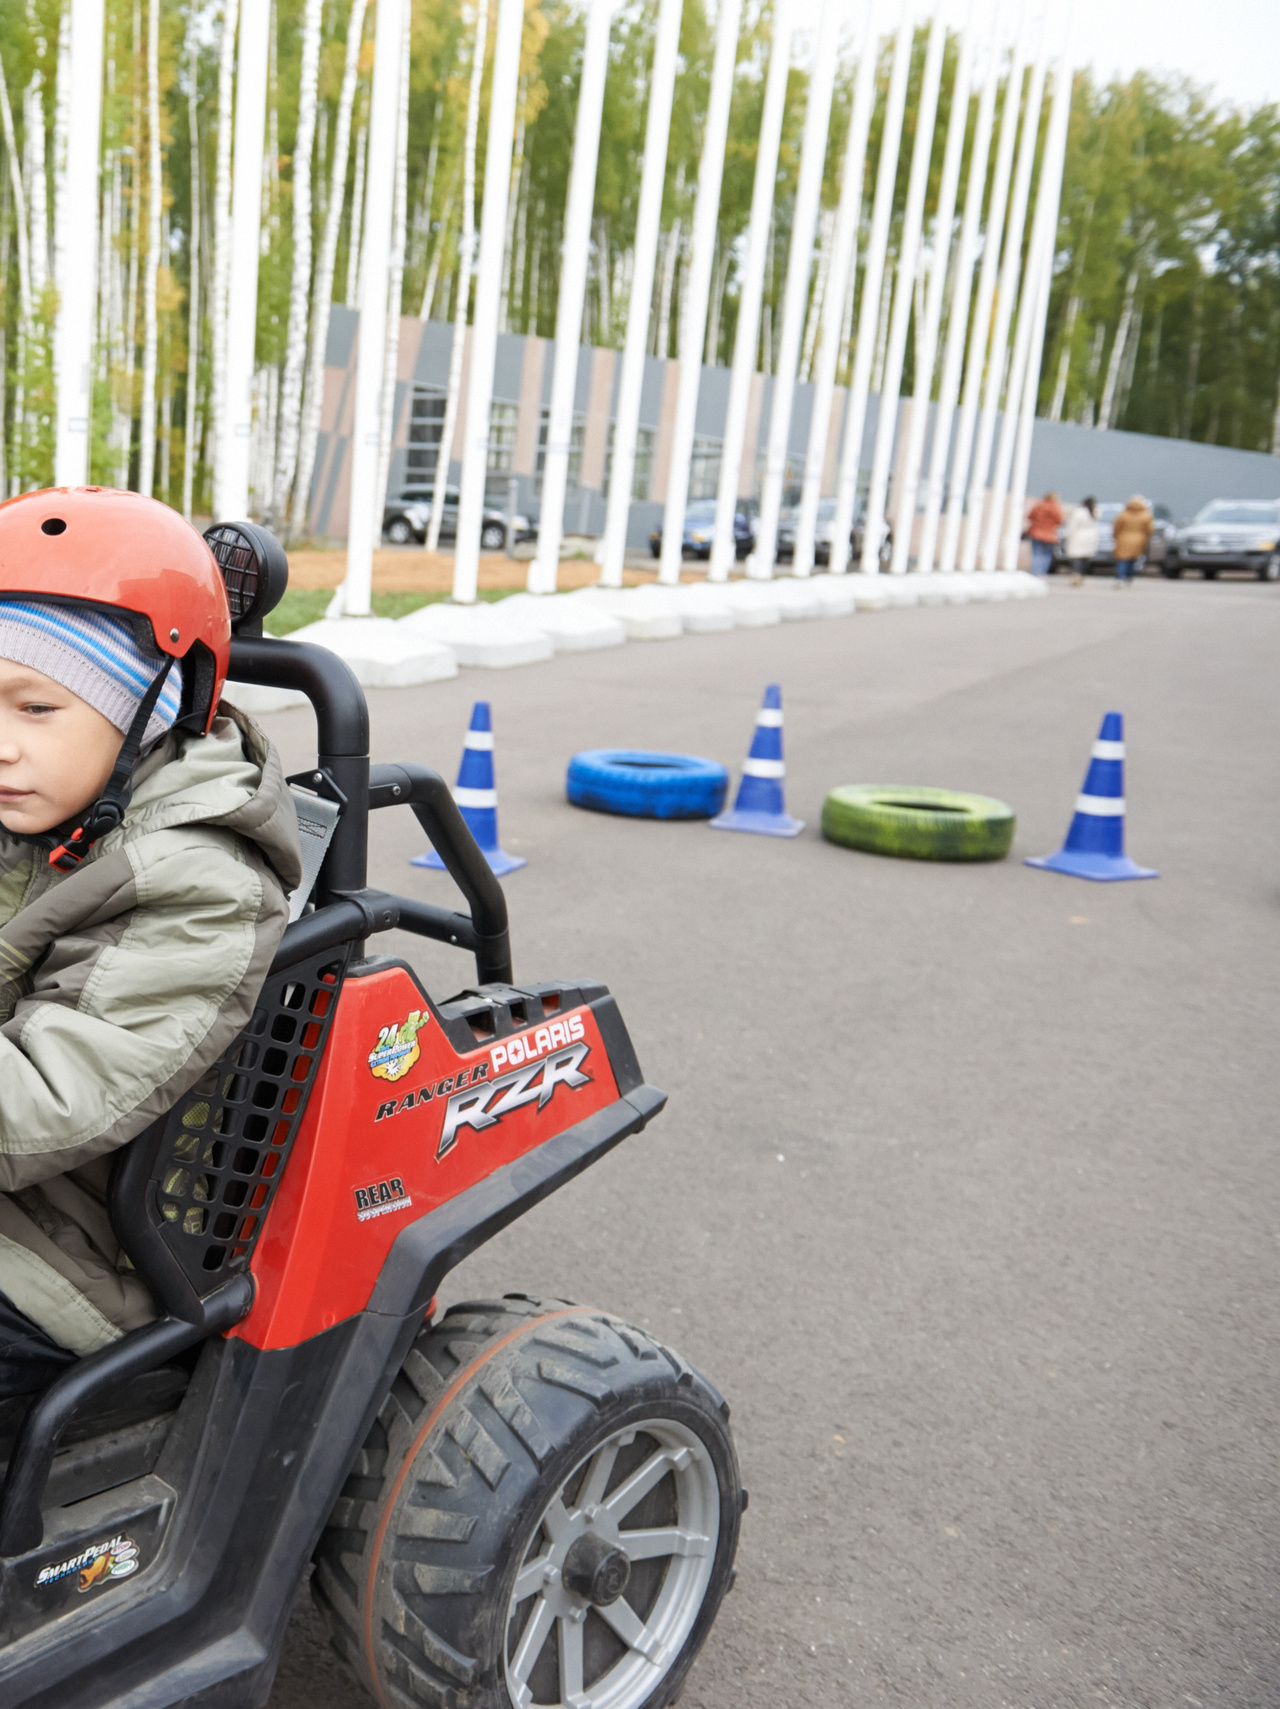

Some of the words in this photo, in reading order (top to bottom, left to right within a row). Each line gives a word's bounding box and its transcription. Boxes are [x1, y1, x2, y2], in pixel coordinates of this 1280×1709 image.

[375, 1023, 399, 1052] 24
[490, 1014, 585, 1072] POLARIS
[374, 1062, 489, 1122] RANGER
[434, 1041, 594, 1161] RZR
[354, 1177, 405, 1210] REAR
